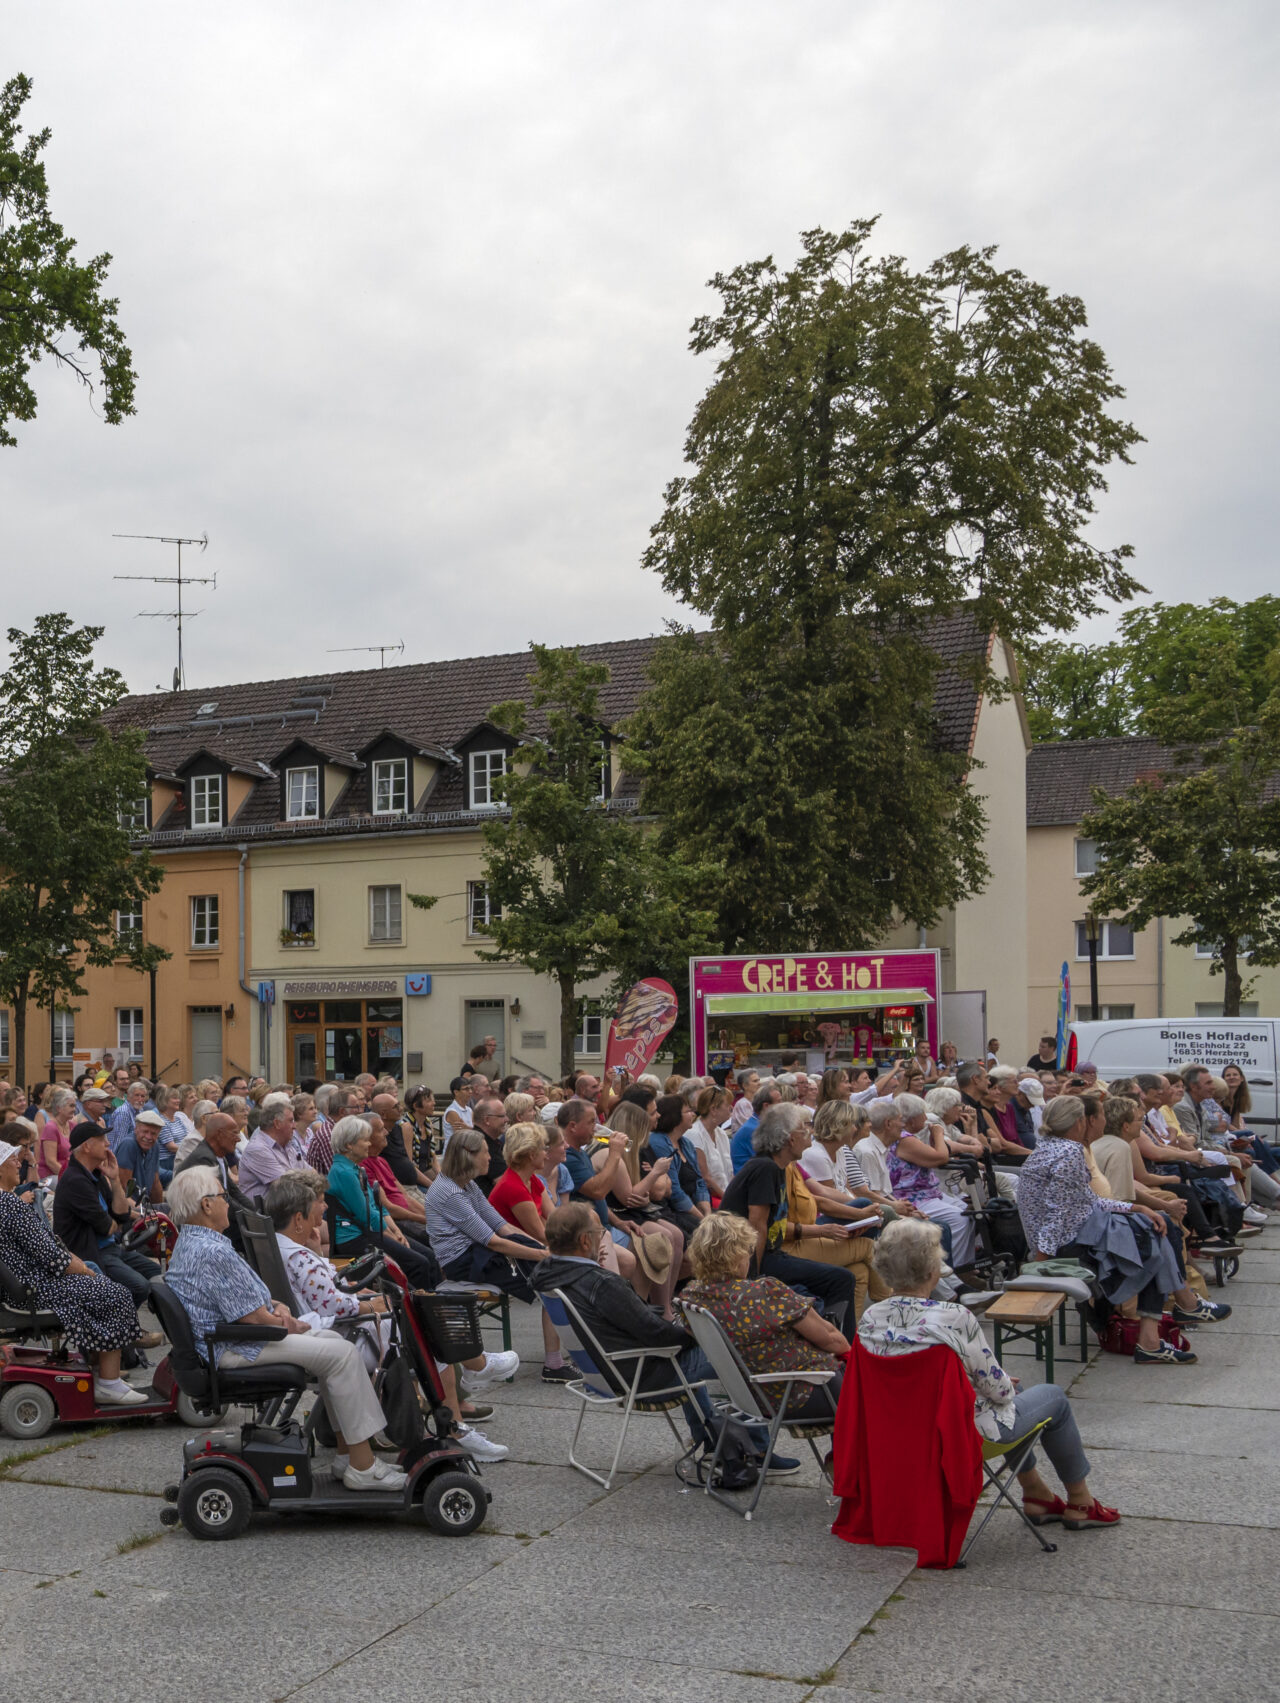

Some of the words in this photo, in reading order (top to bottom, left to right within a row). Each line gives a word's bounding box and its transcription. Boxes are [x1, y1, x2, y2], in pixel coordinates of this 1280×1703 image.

[742, 958, 809, 993] CREPE
[815, 961, 835, 989] &
[284, 981, 336, 993] REISEBÜRO
[336, 980, 398, 993] RHEINSBERG
[1160, 1030, 1202, 1040] Bolles
[1206, 1031, 1268, 1042] Hofladen
[1190, 1041, 1231, 1049] Eichholz
[1173, 1048, 1202, 1056] 16835
[1205, 1049, 1249, 1058] Herzberg
